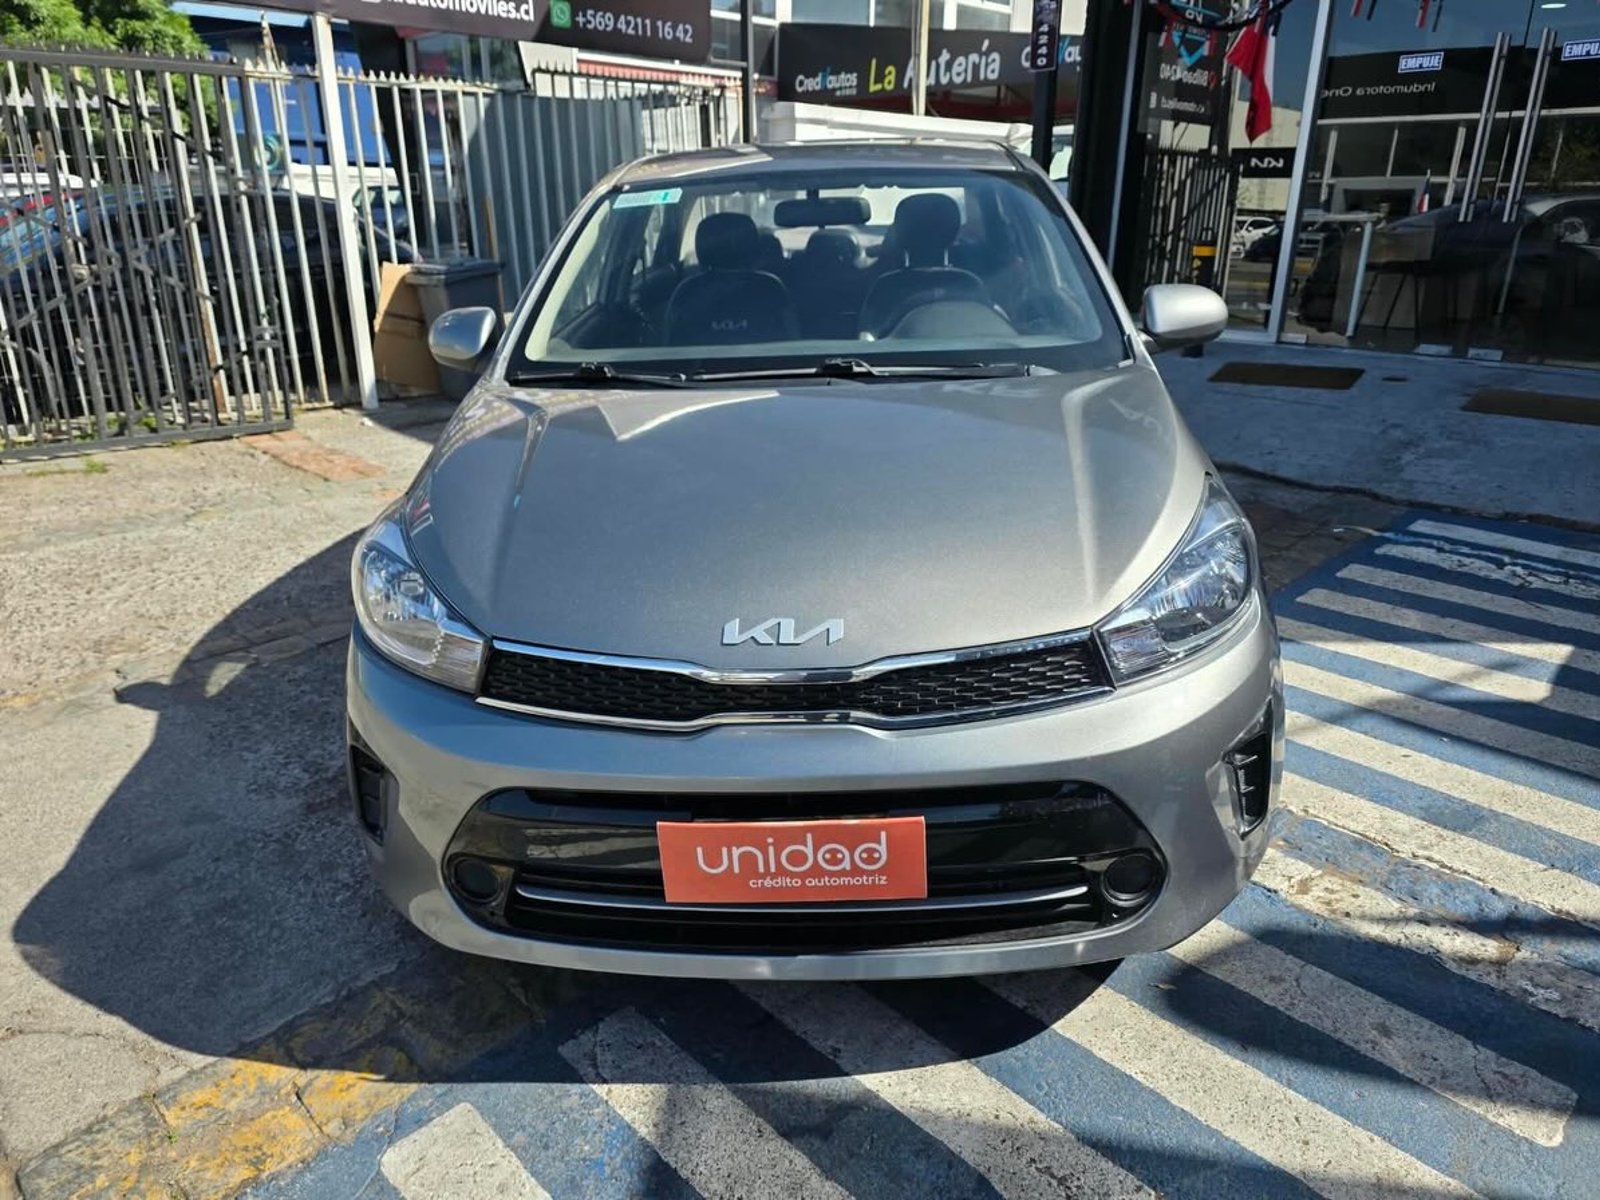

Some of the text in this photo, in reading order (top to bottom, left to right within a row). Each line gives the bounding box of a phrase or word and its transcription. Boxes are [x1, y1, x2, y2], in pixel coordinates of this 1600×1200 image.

[575, 10, 693, 43] +569 4211 16 42
[1401, 56, 1441, 69] EMPUJE
[1564, 42, 1600, 57] EMPU
[869, 58, 896, 93] La
[722, 617, 845, 646] KIA
[696, 831, 888, 874] unidad
[749, 873, 888, 888] crédito automotriz
